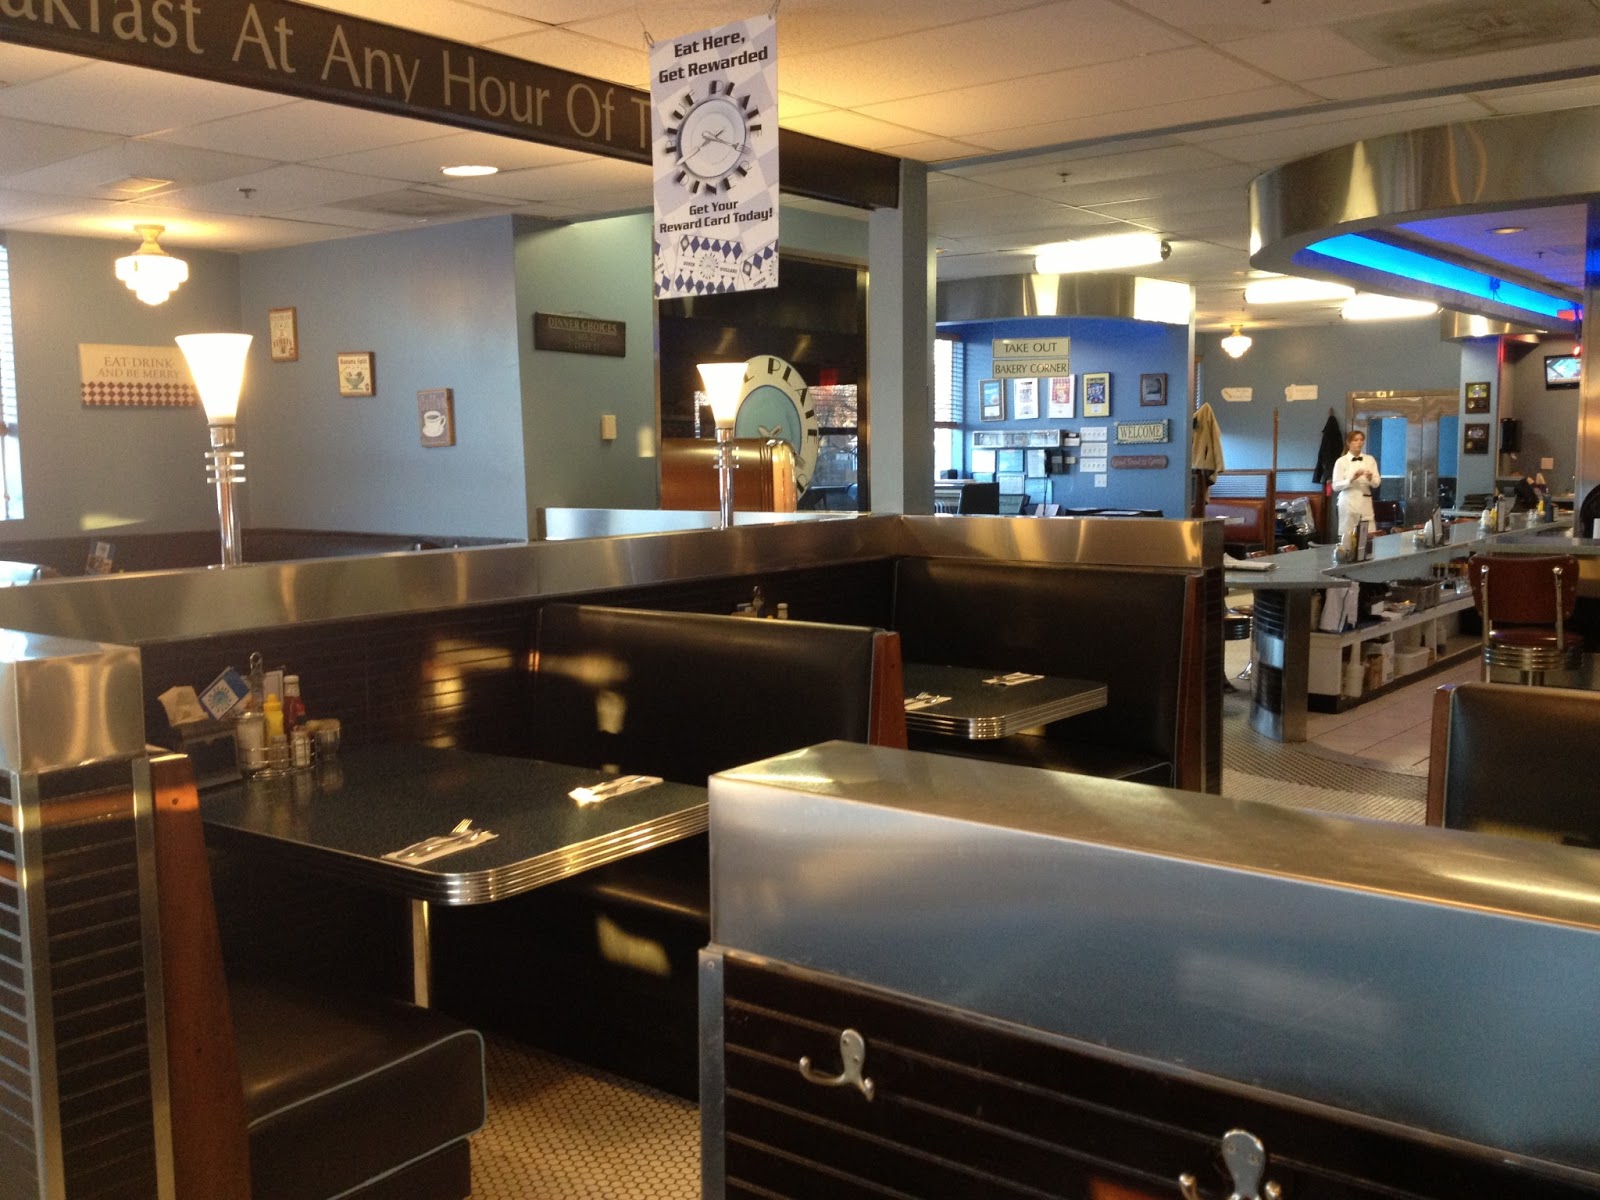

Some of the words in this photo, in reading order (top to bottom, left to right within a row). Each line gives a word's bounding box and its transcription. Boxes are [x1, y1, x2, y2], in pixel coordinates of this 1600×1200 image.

[674, 41, 699, 58] Eat
[702, 32, 746, 51] Here,
[231, 2, 297, 74] At
[320, 25, 420, 104] Any
[443, 50, 550, 127] Hour
[566, 82, 615, 141] Of
[658, 67, 685, 84] Get
[687, 46, 769, 77] Rewarded
[690, 205, 711, 216] Get
[712, 201, 739, 213] Your
[659, 218, 702, 234] Reward
[704, 214, 731, 227] Card
[733, 207, 773, 223] Today!
[548, 317, 580, 329] DINNER
[581, 321, 617, 333] CHOICES
[1004, 343, 1029, 353] TAKE
[1033, 342, 1058, 353] OUT
[104, 356, 128, 368] EAT
[132, 357, 175, 369] DRINK
[995, 364, 1027, 374] BAKERY
[1030, 363, 1068, 374] CORNER
[97, 368, 124, 379] AND
[126, 368, 140, 379] BE
[142, 369, 180, 380] MERRY
[1120, 425, 1162, 439] WELCOME
